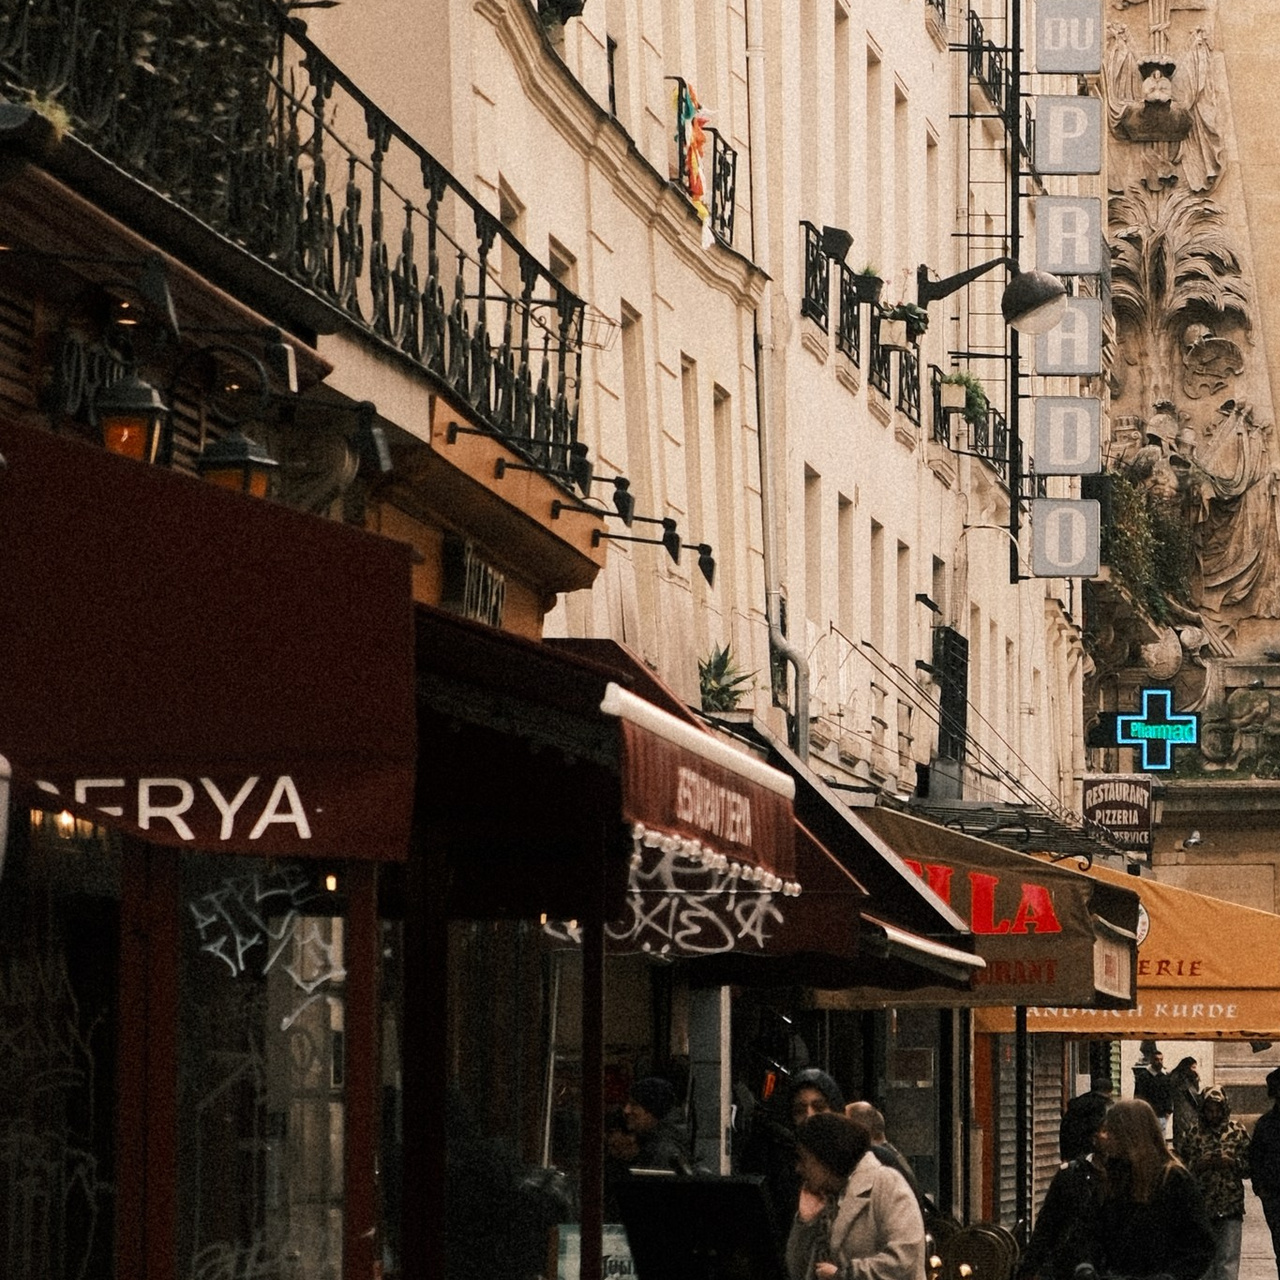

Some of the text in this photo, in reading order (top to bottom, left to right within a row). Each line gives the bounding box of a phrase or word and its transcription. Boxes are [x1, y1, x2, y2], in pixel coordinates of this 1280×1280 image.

[1044, 17, 1096, 51] DU
[1044, 104, 1093, 568] PRADO
[35, 775, 312, 841] ERYA
[1085, 782, 1149, 810] RESTAURANT
[1095, 809, 1139, 826] PIZZERIA
[1155, 1003, 1239, 1019] KURDE
